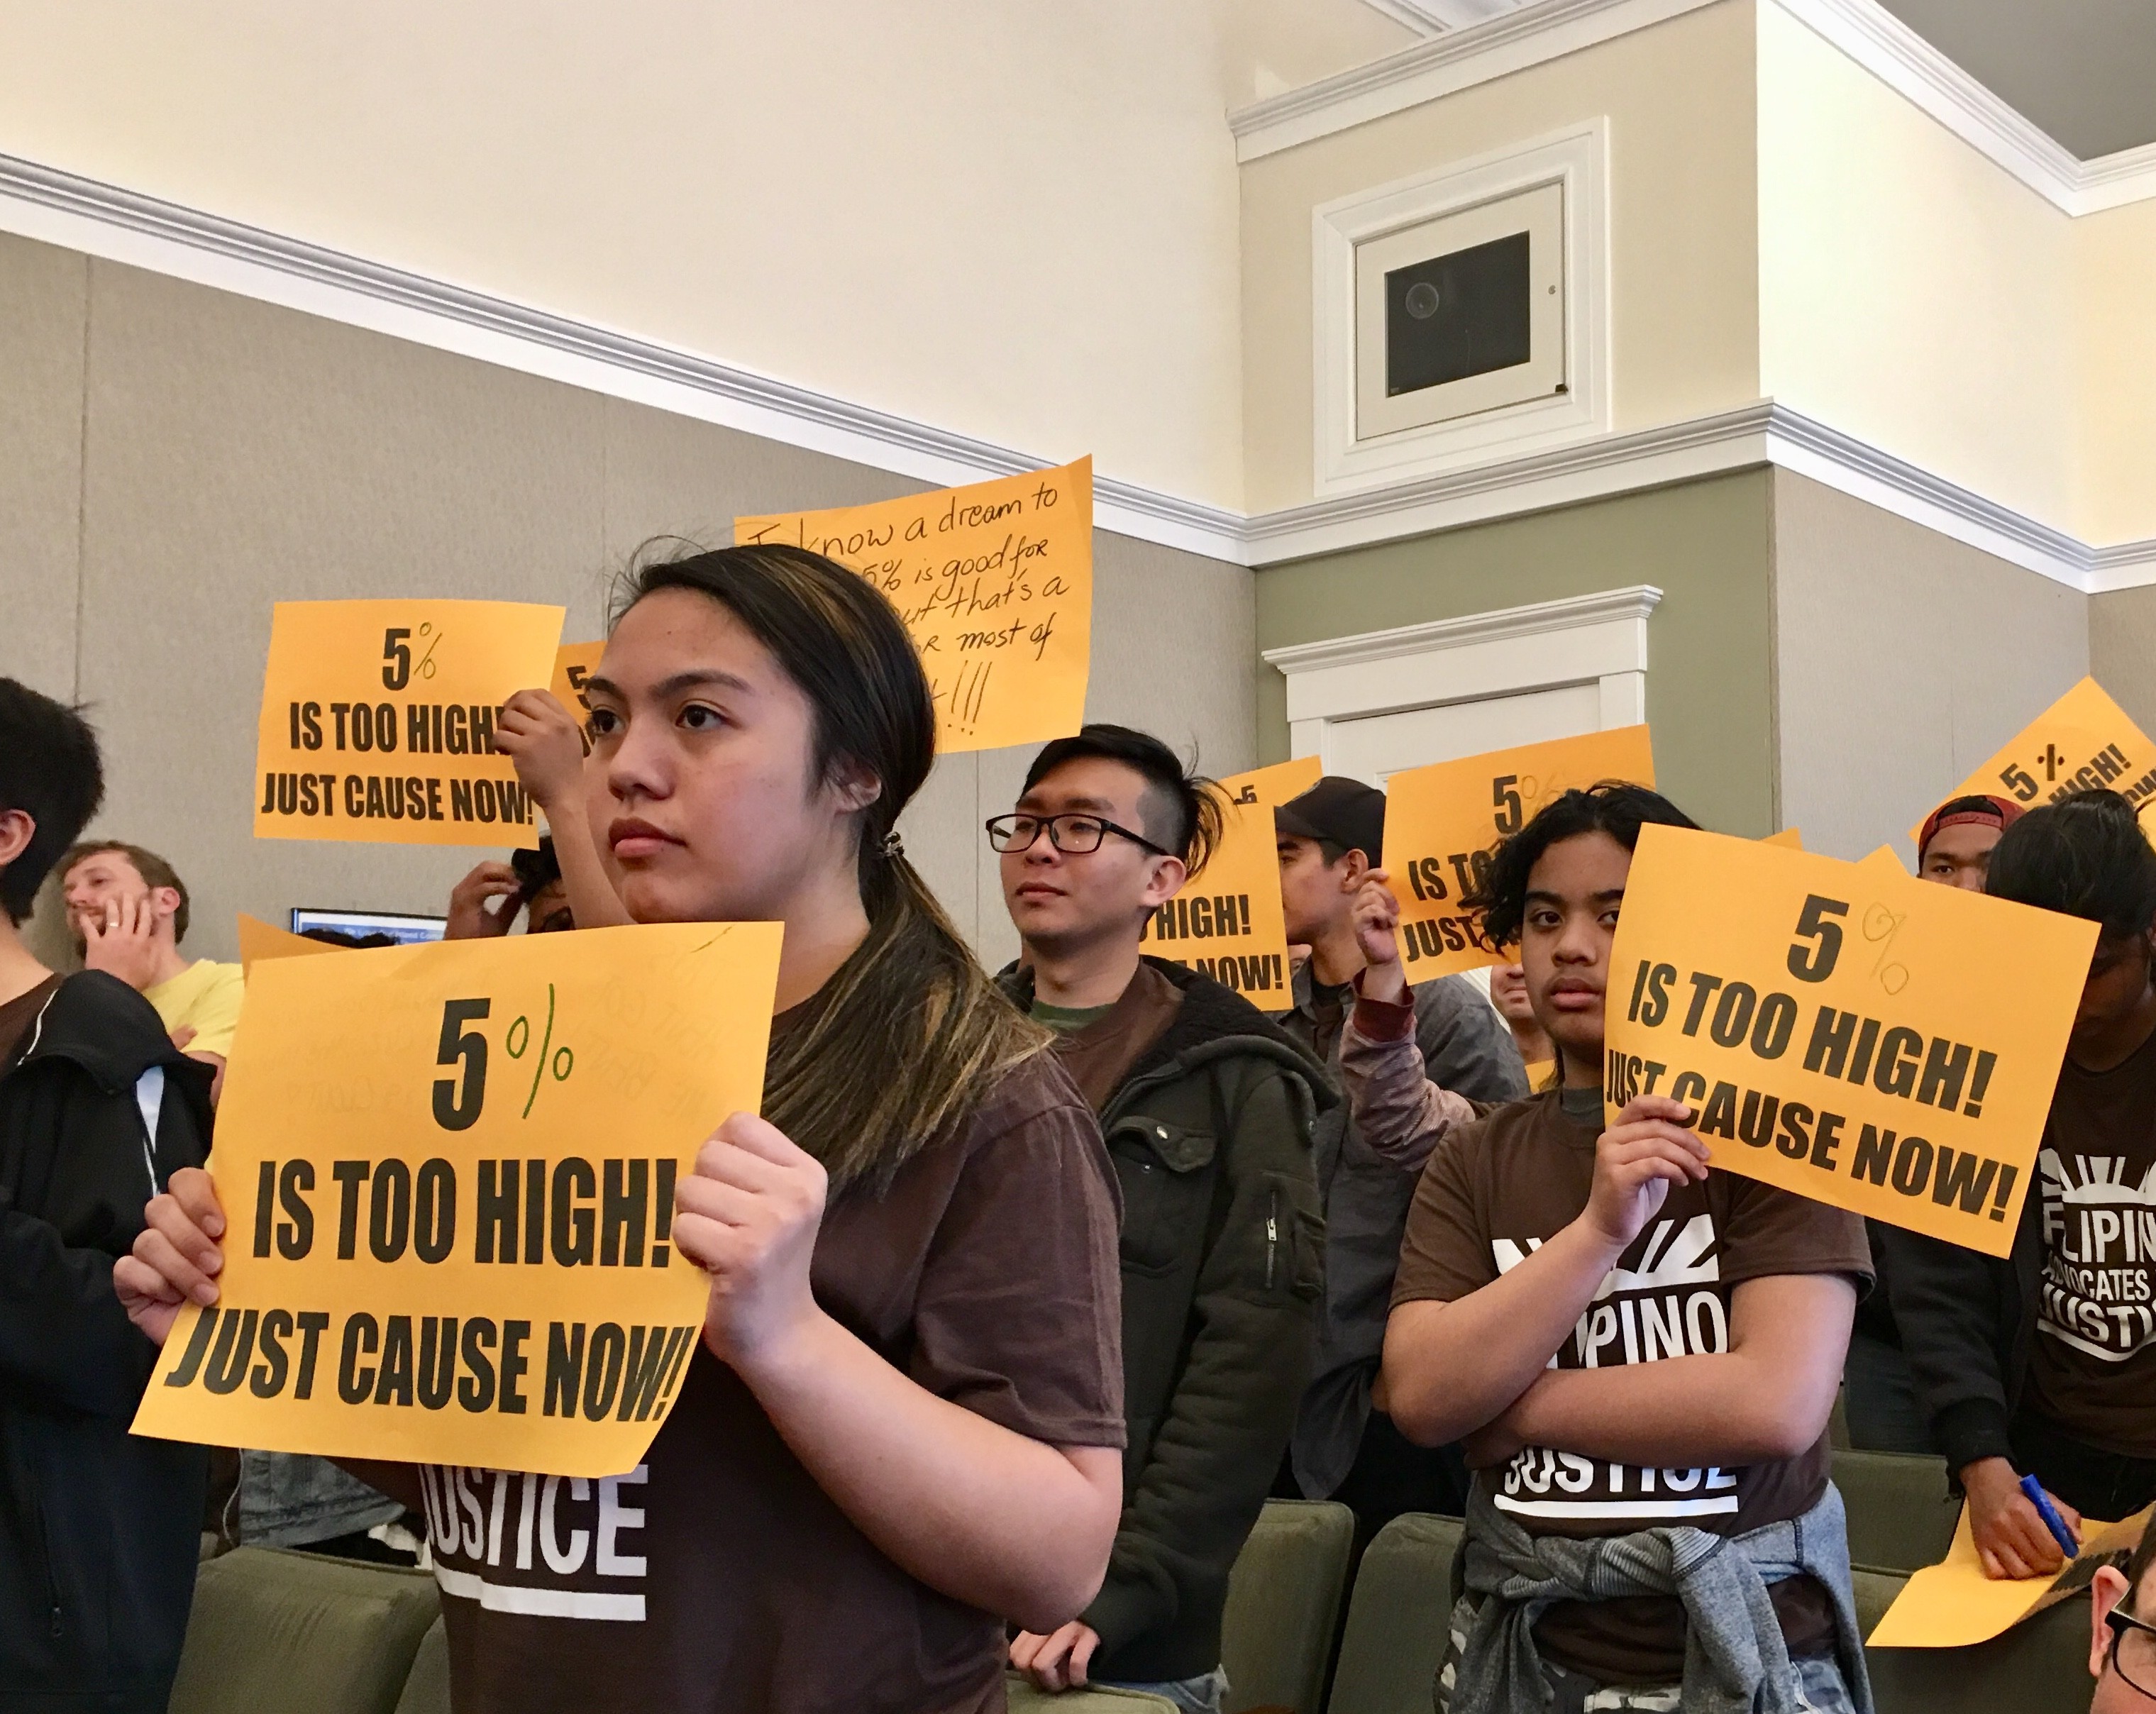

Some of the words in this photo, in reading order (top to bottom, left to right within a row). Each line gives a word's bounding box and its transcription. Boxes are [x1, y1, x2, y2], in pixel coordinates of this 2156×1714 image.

[800, 517, 894, 556] know
[905, 516, 928, 542] a
[939, 496, 1022, 533] dream
[1031, 482, 1058, 512] to
[914, 558, 933, 585] is
[941, 533, 1013, 601] good
[900, 592, 938, 626] ut
[944, 568, 1032, 619] that's
[1042, 575, 1071, 597] a
[956, 618, 1027, 652] most
[1030, 612, 1057, 661] of
[289, 702, 322, 751] IS
[331, 702, 397, 753] TOO
[261, 772, 336, 817] JUST
[344, 774, 443, 821] CAUSE
[1408, 856, 1448, 901] IS
[1156, 894, 1251, 941] HIGH!
[1403, 915, 1482, 963] JUST
[1627, 959, 1677, 1028] IS
[1681, 971, 1798, 1061] TOO
[1802, 1006, 1998, 1119] HIGH!
[1606, 1049, 1667, 1108] JUST
[1667, 1070, 1846, 1171] CAUSE
[1850, 1122, 2018, 1223] NOW!
[253, 1159, 314, 1260] IS
[332, 1156, 457, 1264] TOO
[474, 1156, 678, 1267] HIGH!
[164, 1307, 330, 1400] JUST
[338, 1312, 531, 1415] CAUSE
[543, 1321, 696, 1422] NOW!
